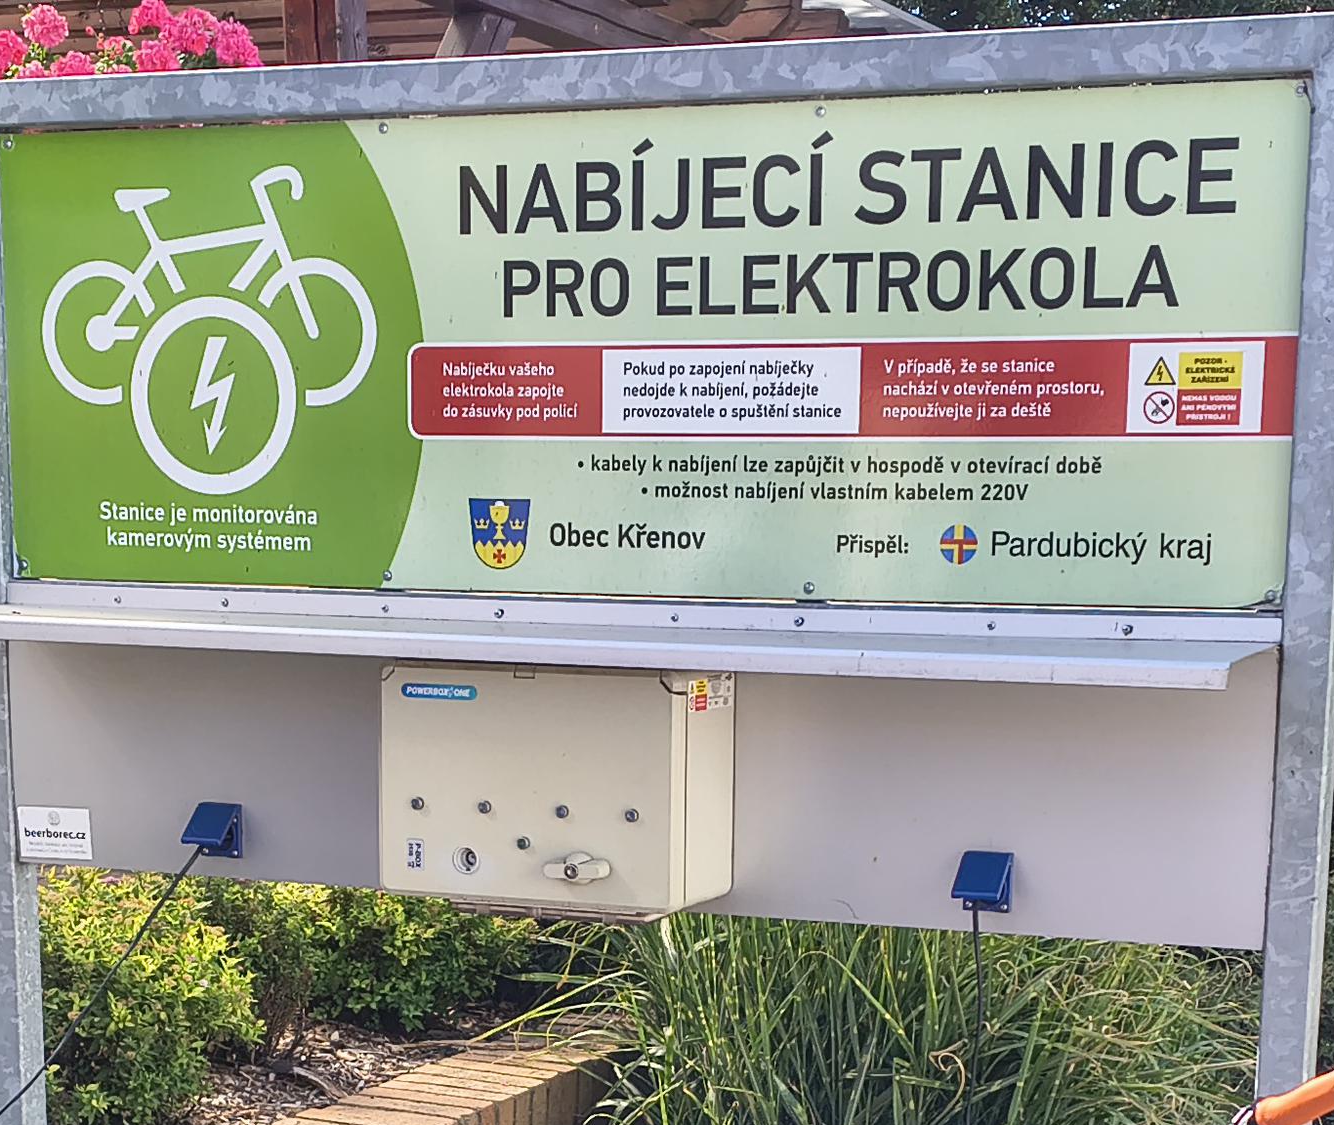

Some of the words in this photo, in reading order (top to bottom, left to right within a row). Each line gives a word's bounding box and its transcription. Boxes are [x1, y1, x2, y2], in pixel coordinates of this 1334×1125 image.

[459, 130, 833, 235] NABÍJECÍ
[854, 137, 1240, 225] STANICE
[503, 258, 629, 318] PRO
[657, 245, 1179, 317] ELEKTROKOLA
[443, 362, 505, 380] Nabíječku
[509, 361, 554, 376] vašeho
[624, 361, 665, 375] Pokud
[669, 365, 685, 379] po
[689, 360, 746, 378] zapojení
[749, 360, 814, 380] nabíječky
[884, 359, 894, 373] V
[898, 358, 955, 377] případě,
[960, 358, 977, 373] že
[981, 362, 998, 373] se
[1002, 358, 1055, 373] stanice
[443, 382, 514, 397] elektrokola
[517, 383, 564, 400] zapojte
[623, 382, 675, 400] nedojde
[680, 382, 687, 397] k
[692, 382, 748, 400] nabíjení,
[753, 381, 819, 400] požádejte
[883, 380, 938, 396] nachází
[941, 385, 950, 395] v
[954, 379, 1032, 395] otevřeném
[1036, 381, 1104, 398] prostoru,
[443, 403, 458, 417] do
[462, 403, 513, 421] zásuvky
[516, 403, 539, 421] pod
[623, 404, 715, 421] provozovatele
[719, 408, 727, 418] o
[731, 403, 789, 421] spuštění
[793, 404, 841, 418] stanice
[883, 402, 973, 421] nepoužívejte
[976, 402, 986, 421] ji
[990, 406, 1006, 417] za
[1011, 402, 1051, 417] deště
[591, 454, 647, 476] kabely
[653, 454, 662, 472] k
[669, 454, 738, 476] nabíjení
[744, 455, 768, 472] lze
[774, 455, 844, 477] zapůjčit
[850, 460, 861, 473] v
[867, 456, 944, 478] hospodě
[951, 461, 961, 473] v
[967, 455, 1050, 474] otevírací
[1056, 456, 1102, 474] době
[655, 481, 728, 498] možnost
[735, 481, 805, 503] nabíjení
[810, 482, 887, 500] vlastním
[895, 482, 973, 501] kabelem
[981, 484, 1029, 501] 220V
[100, 501, 165, 521] Stanice
[170, 502, 187, 526] je
[193, 504, 317, 525] monitorována
[107, 526, 211, 552] kamerovým
[217, 529, 311, 553] systémem
[550, 522, 609, 547] Obec
[618, 523, 705, 549] Křenov
[837, 534, 909, 558] Přispěl:
[991, 531, 1147, 565] Pardubický
[1160, 533, 1211, 566] kraj
